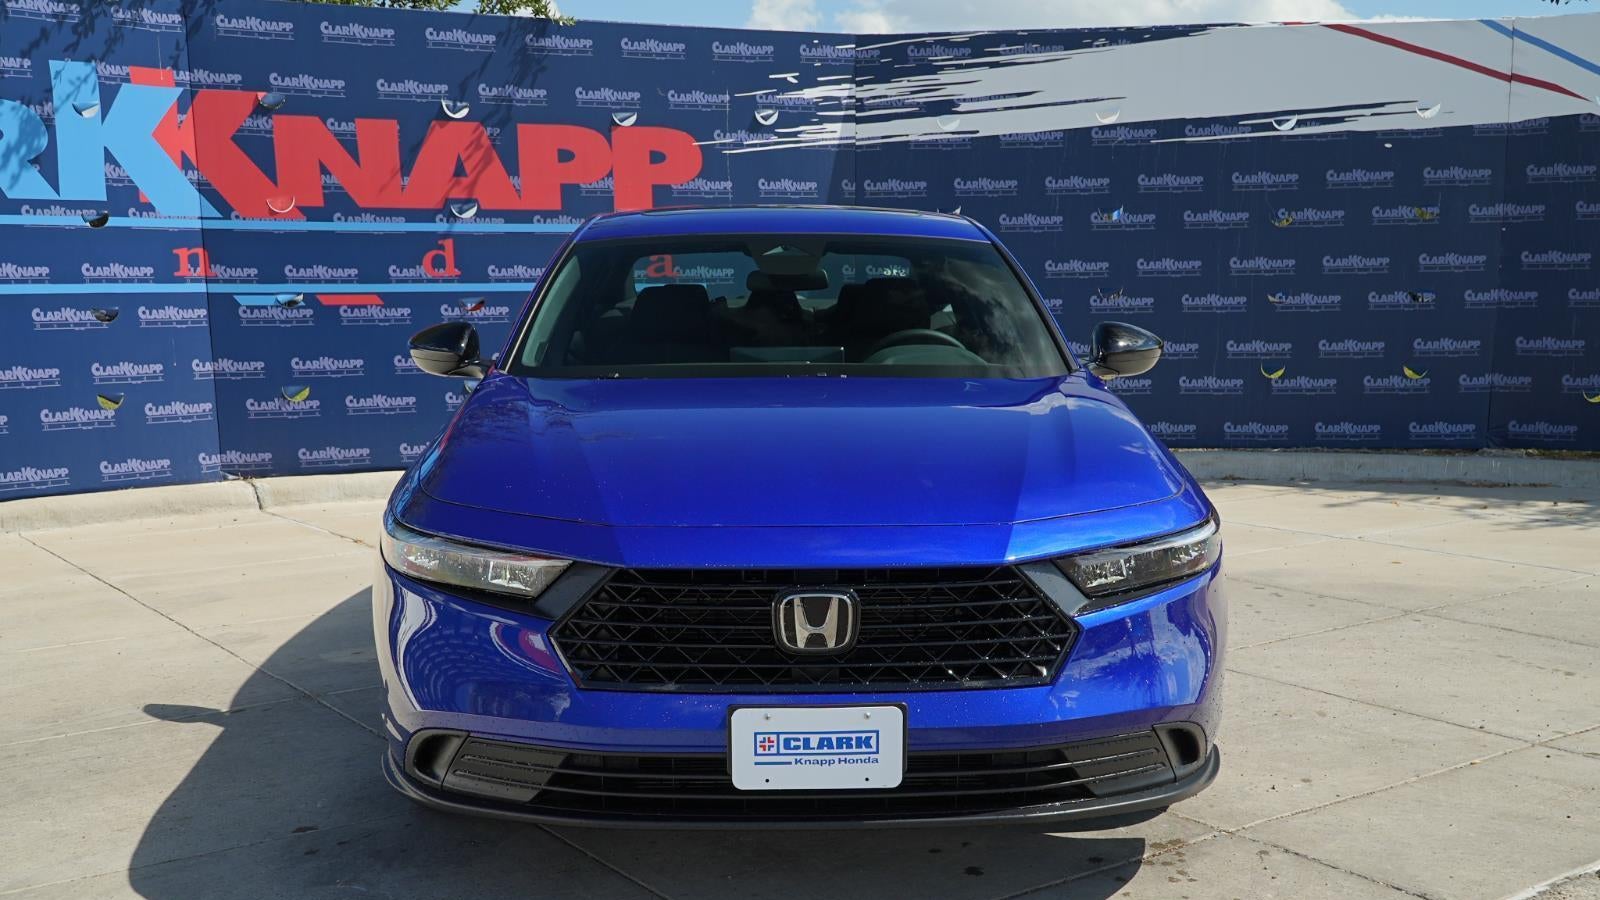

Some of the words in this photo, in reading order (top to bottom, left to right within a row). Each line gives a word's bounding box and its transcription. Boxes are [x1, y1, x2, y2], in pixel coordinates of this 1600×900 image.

[173, 69, 243, 84] LARKKNAPP
[783, 736, 873, 751] CLARK
[794, 757, 836, 767] Knapp
[838, 756, 879, 765] Honda
